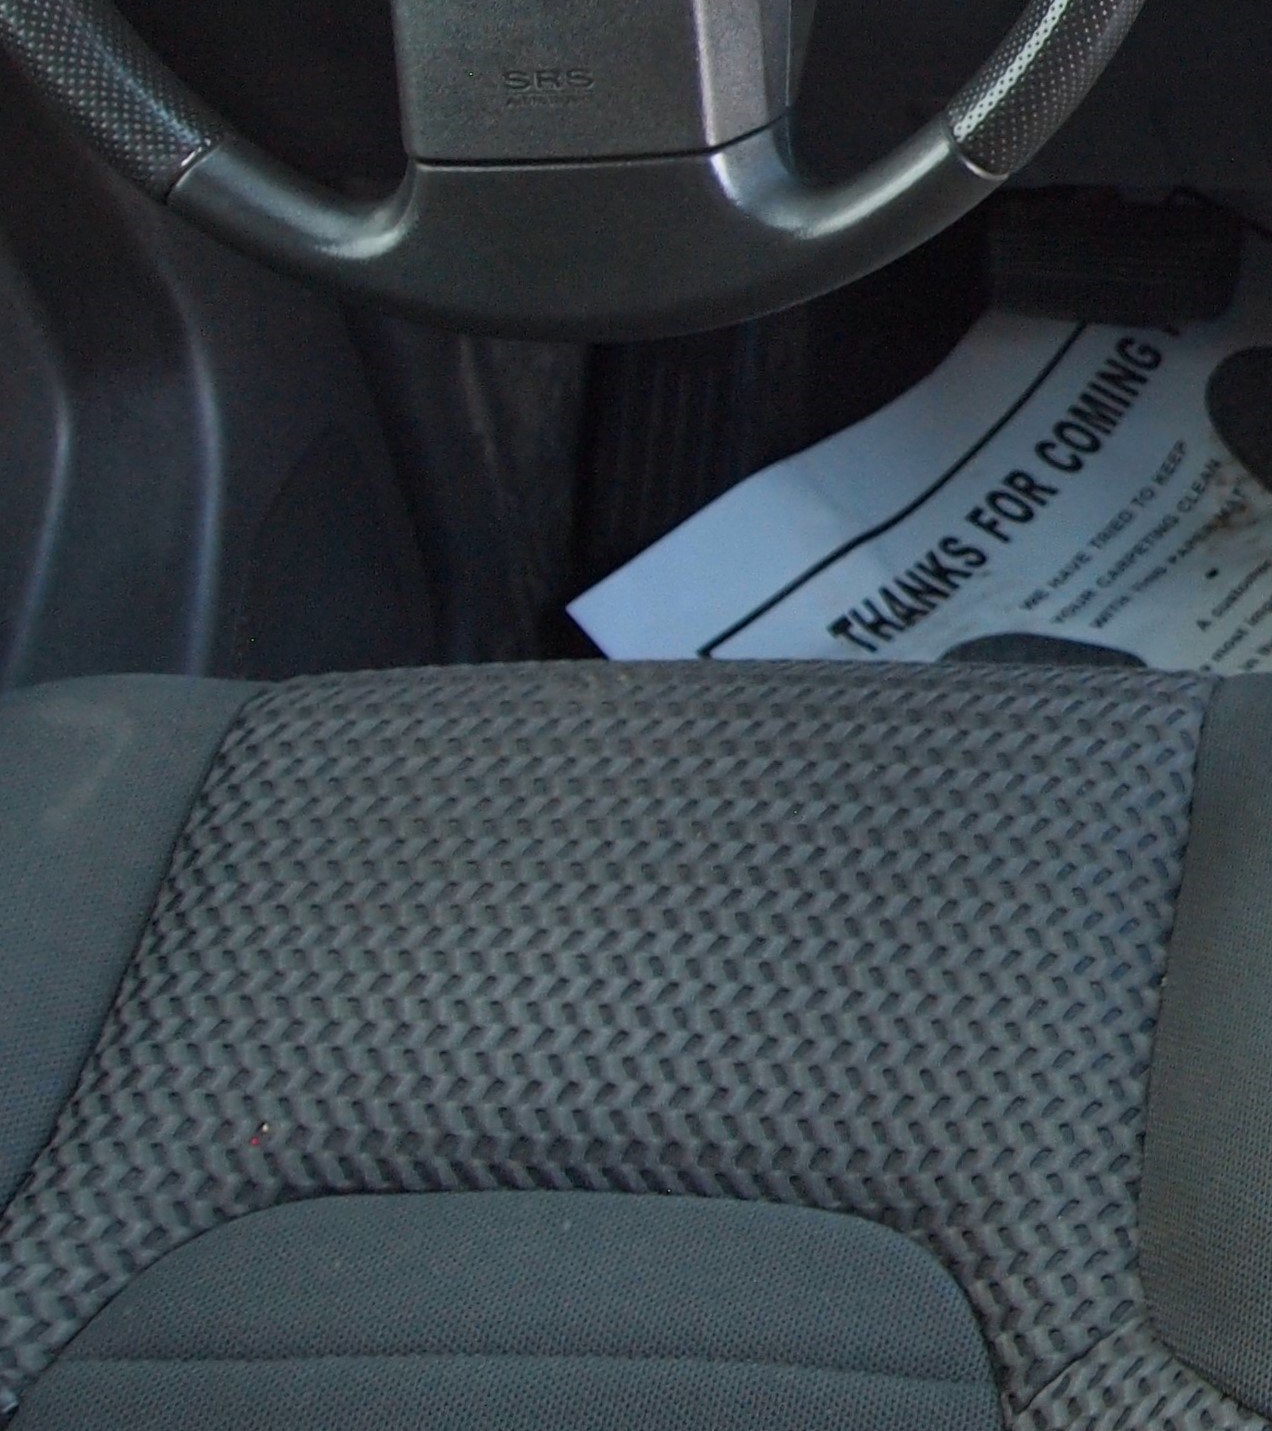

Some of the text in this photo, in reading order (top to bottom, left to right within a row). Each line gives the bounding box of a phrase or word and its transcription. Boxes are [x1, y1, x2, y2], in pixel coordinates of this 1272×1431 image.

[502, 69, 595, 90] SRS
[827, 335, 1163, 654] THANKS FOR COMING
[1130, 485, 1156, 508] TO
